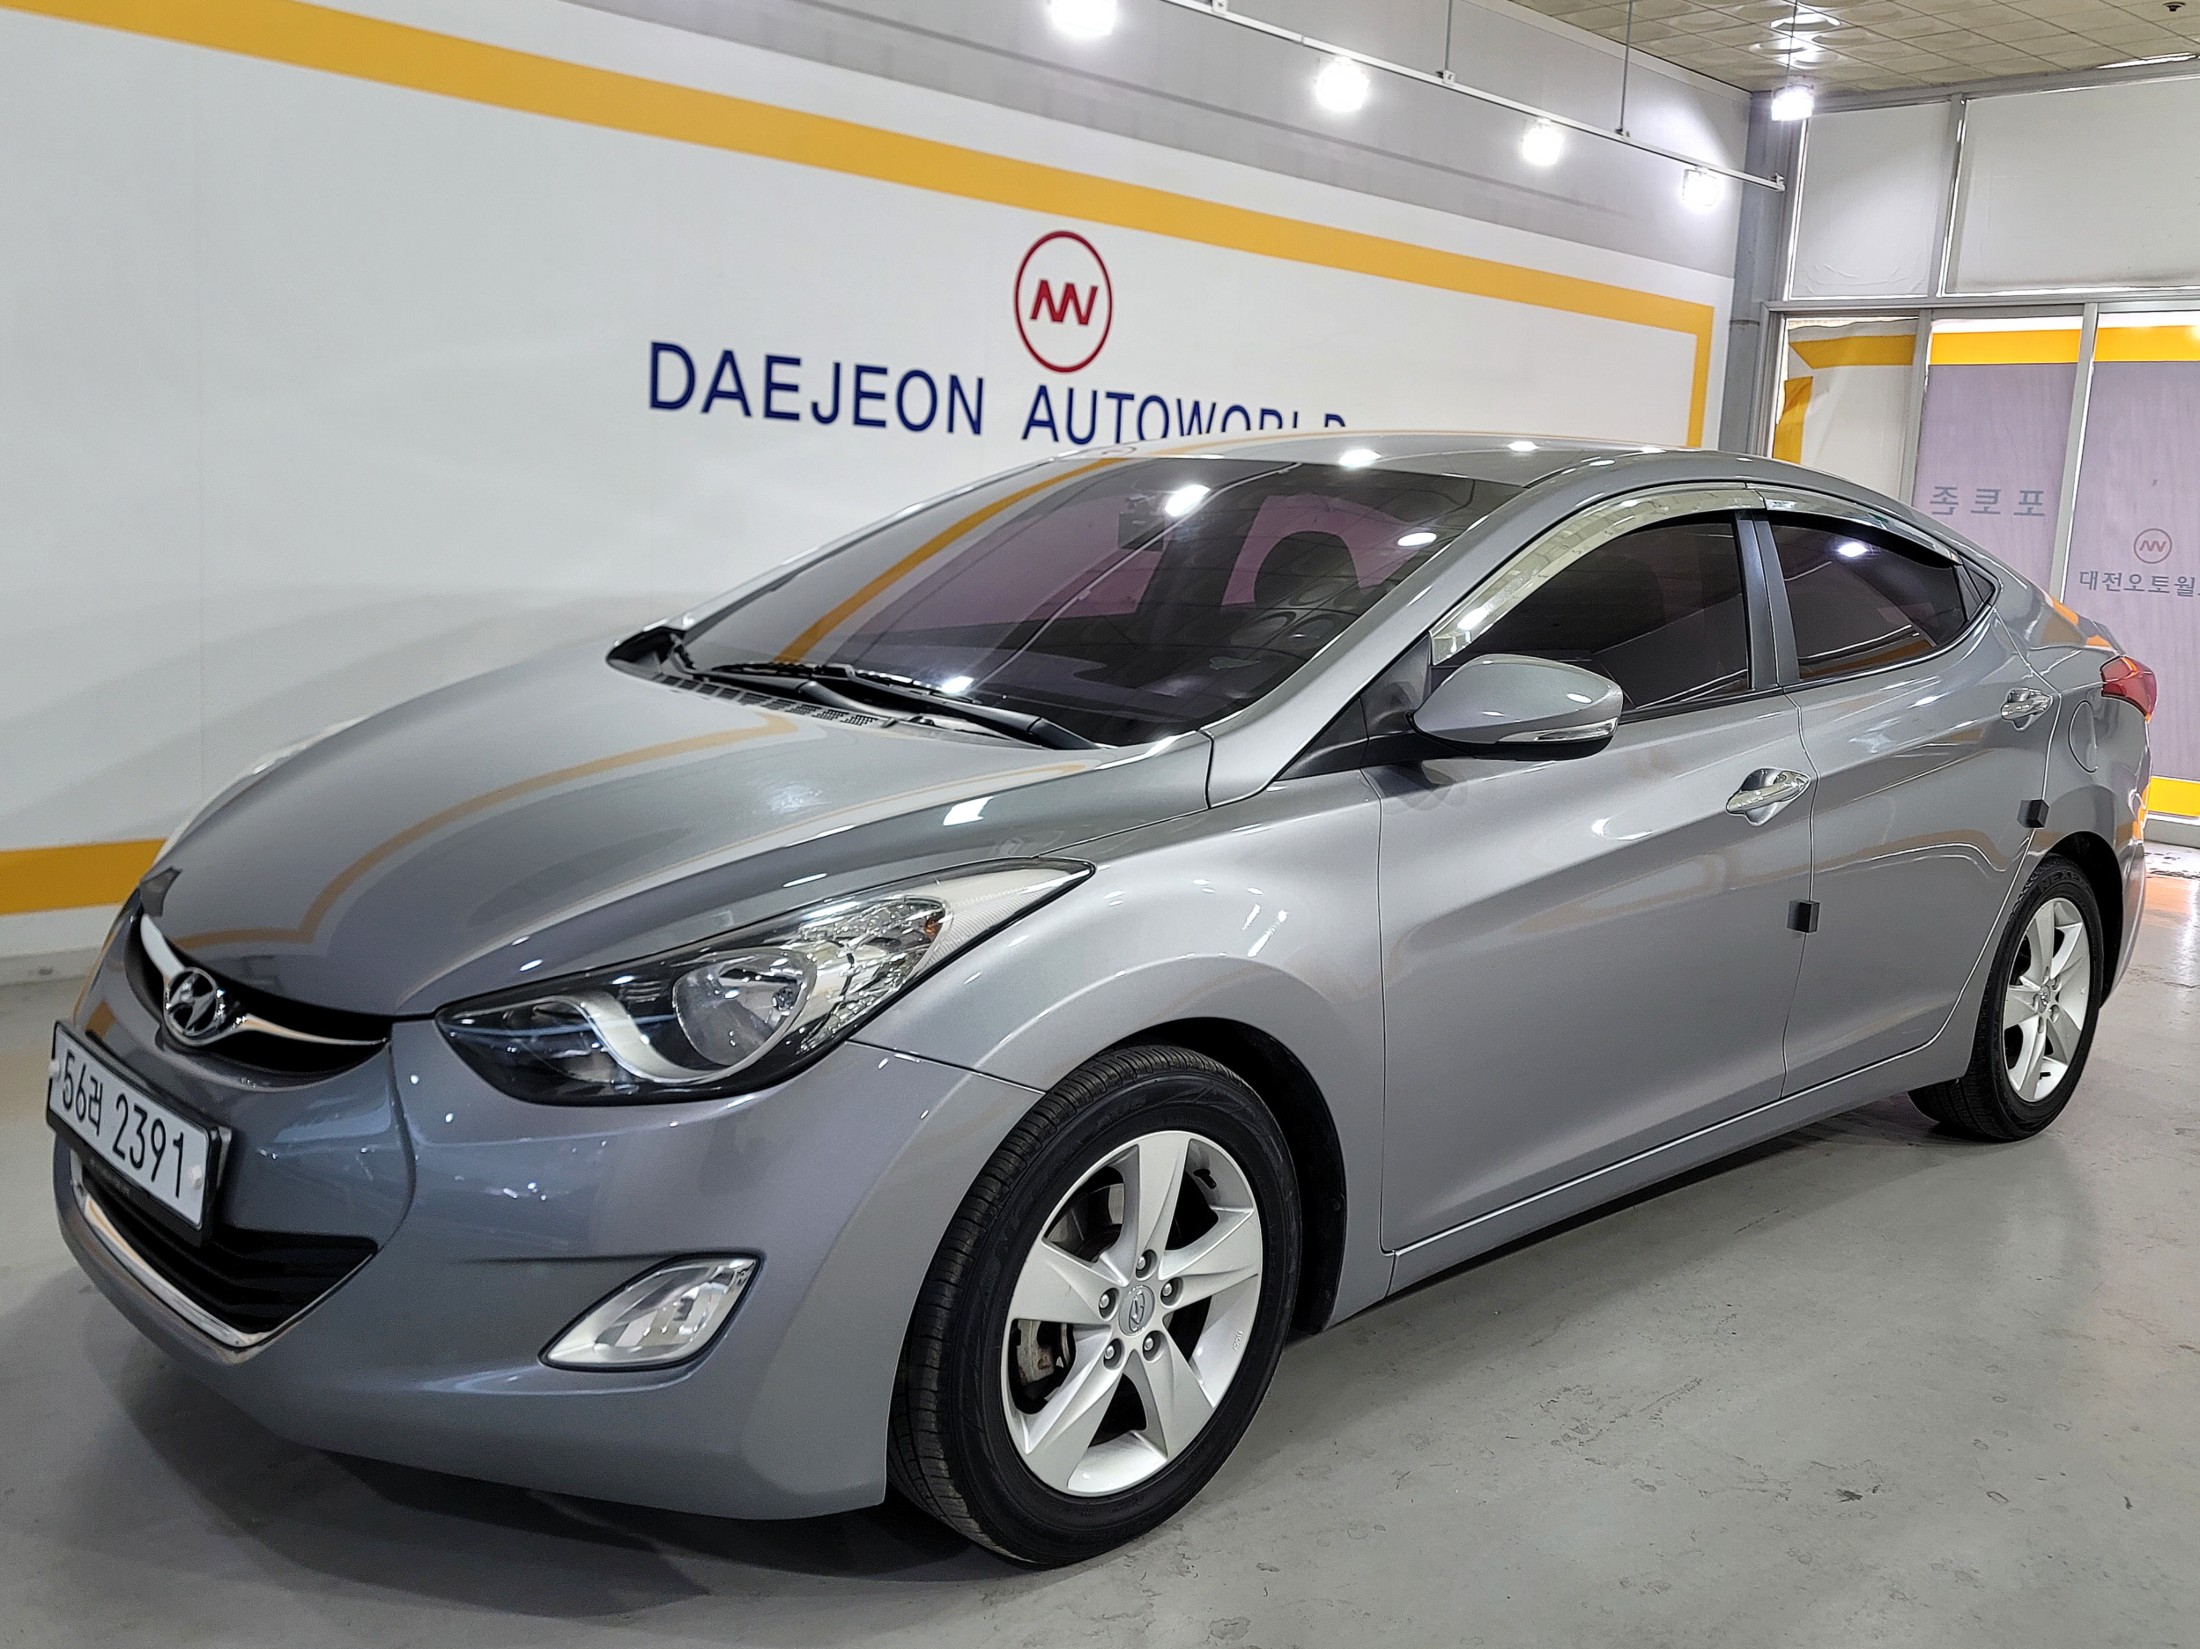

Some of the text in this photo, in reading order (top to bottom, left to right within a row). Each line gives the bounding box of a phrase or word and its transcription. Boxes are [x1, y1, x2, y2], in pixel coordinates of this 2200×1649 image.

[649, 341, 984, 436] DAEJEON
[2079, 569, 2200, 598] 대전오토월
[62, 1048, 184, 1199] 56러 2391
